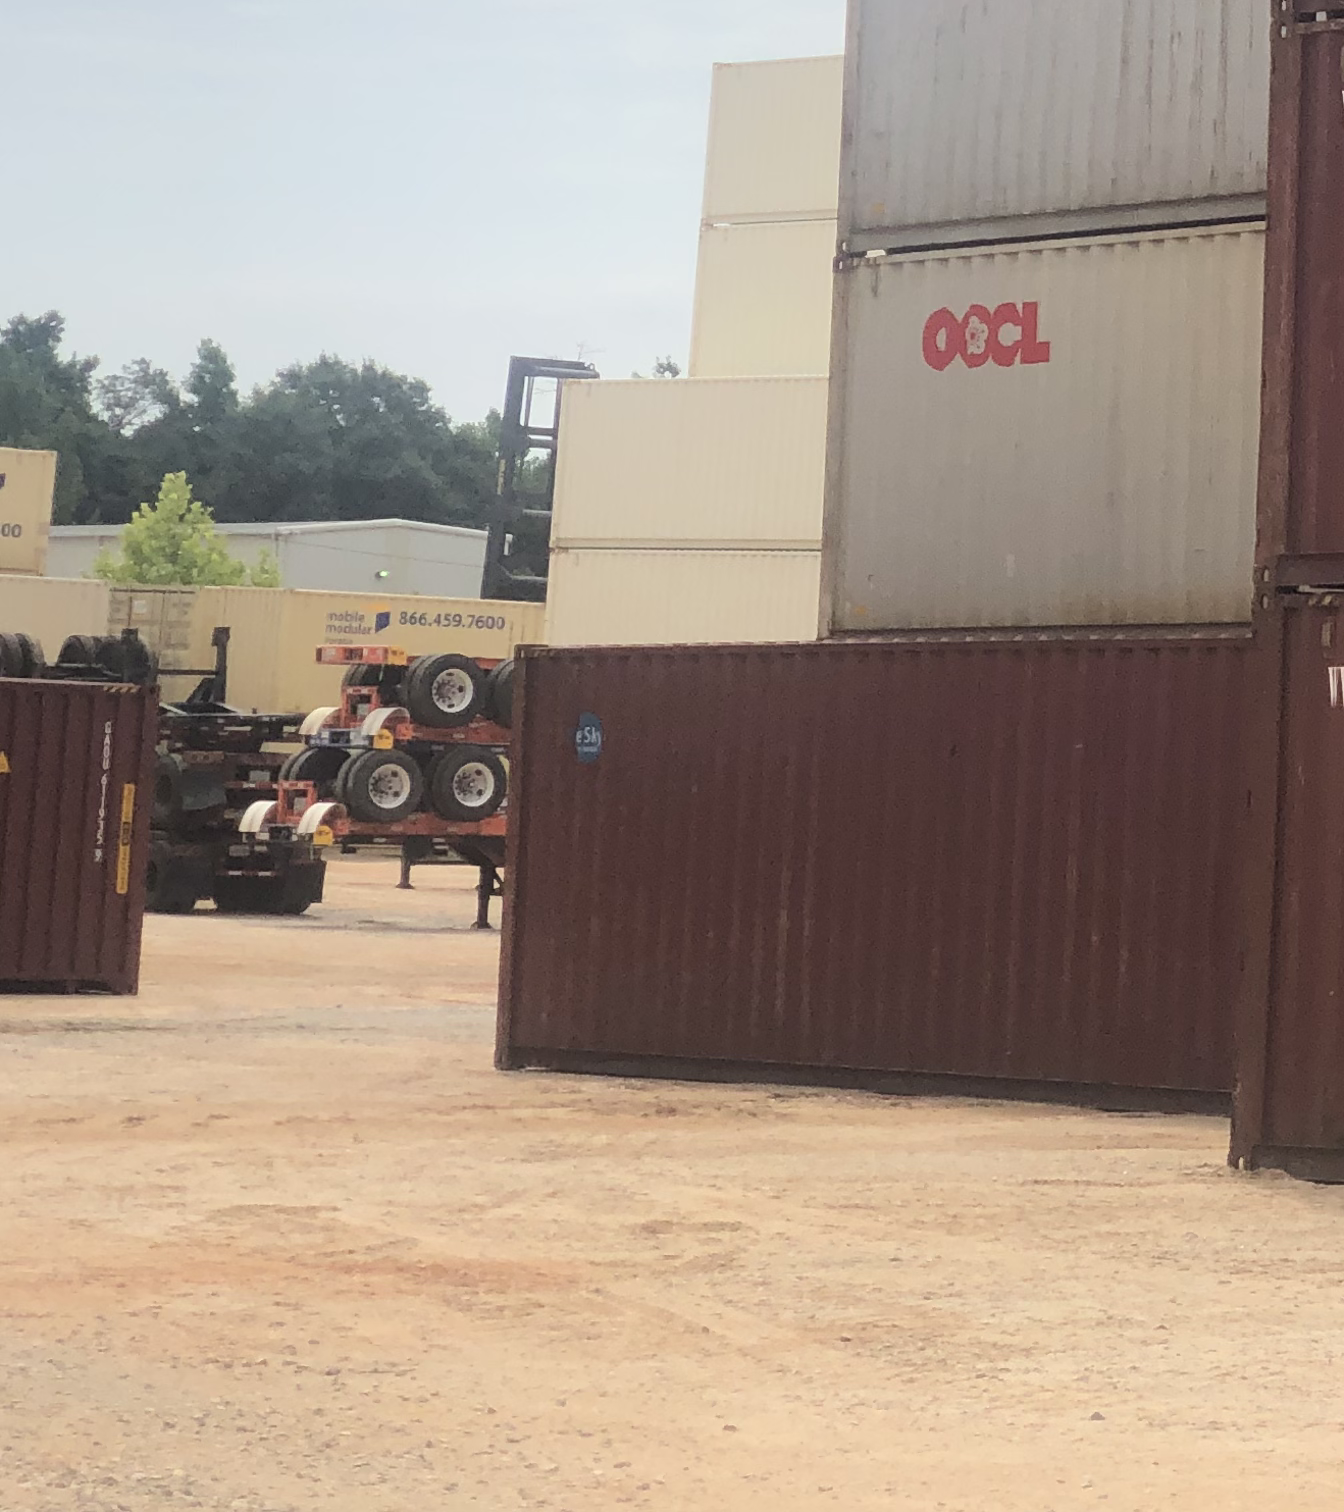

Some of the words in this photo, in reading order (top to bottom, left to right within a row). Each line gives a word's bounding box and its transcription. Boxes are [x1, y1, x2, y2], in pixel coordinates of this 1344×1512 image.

[922, 301, 1050, 371] OOCL
[325, 623, 373, 635] modular
[400, 611, 505, 630] 866.459.7600
